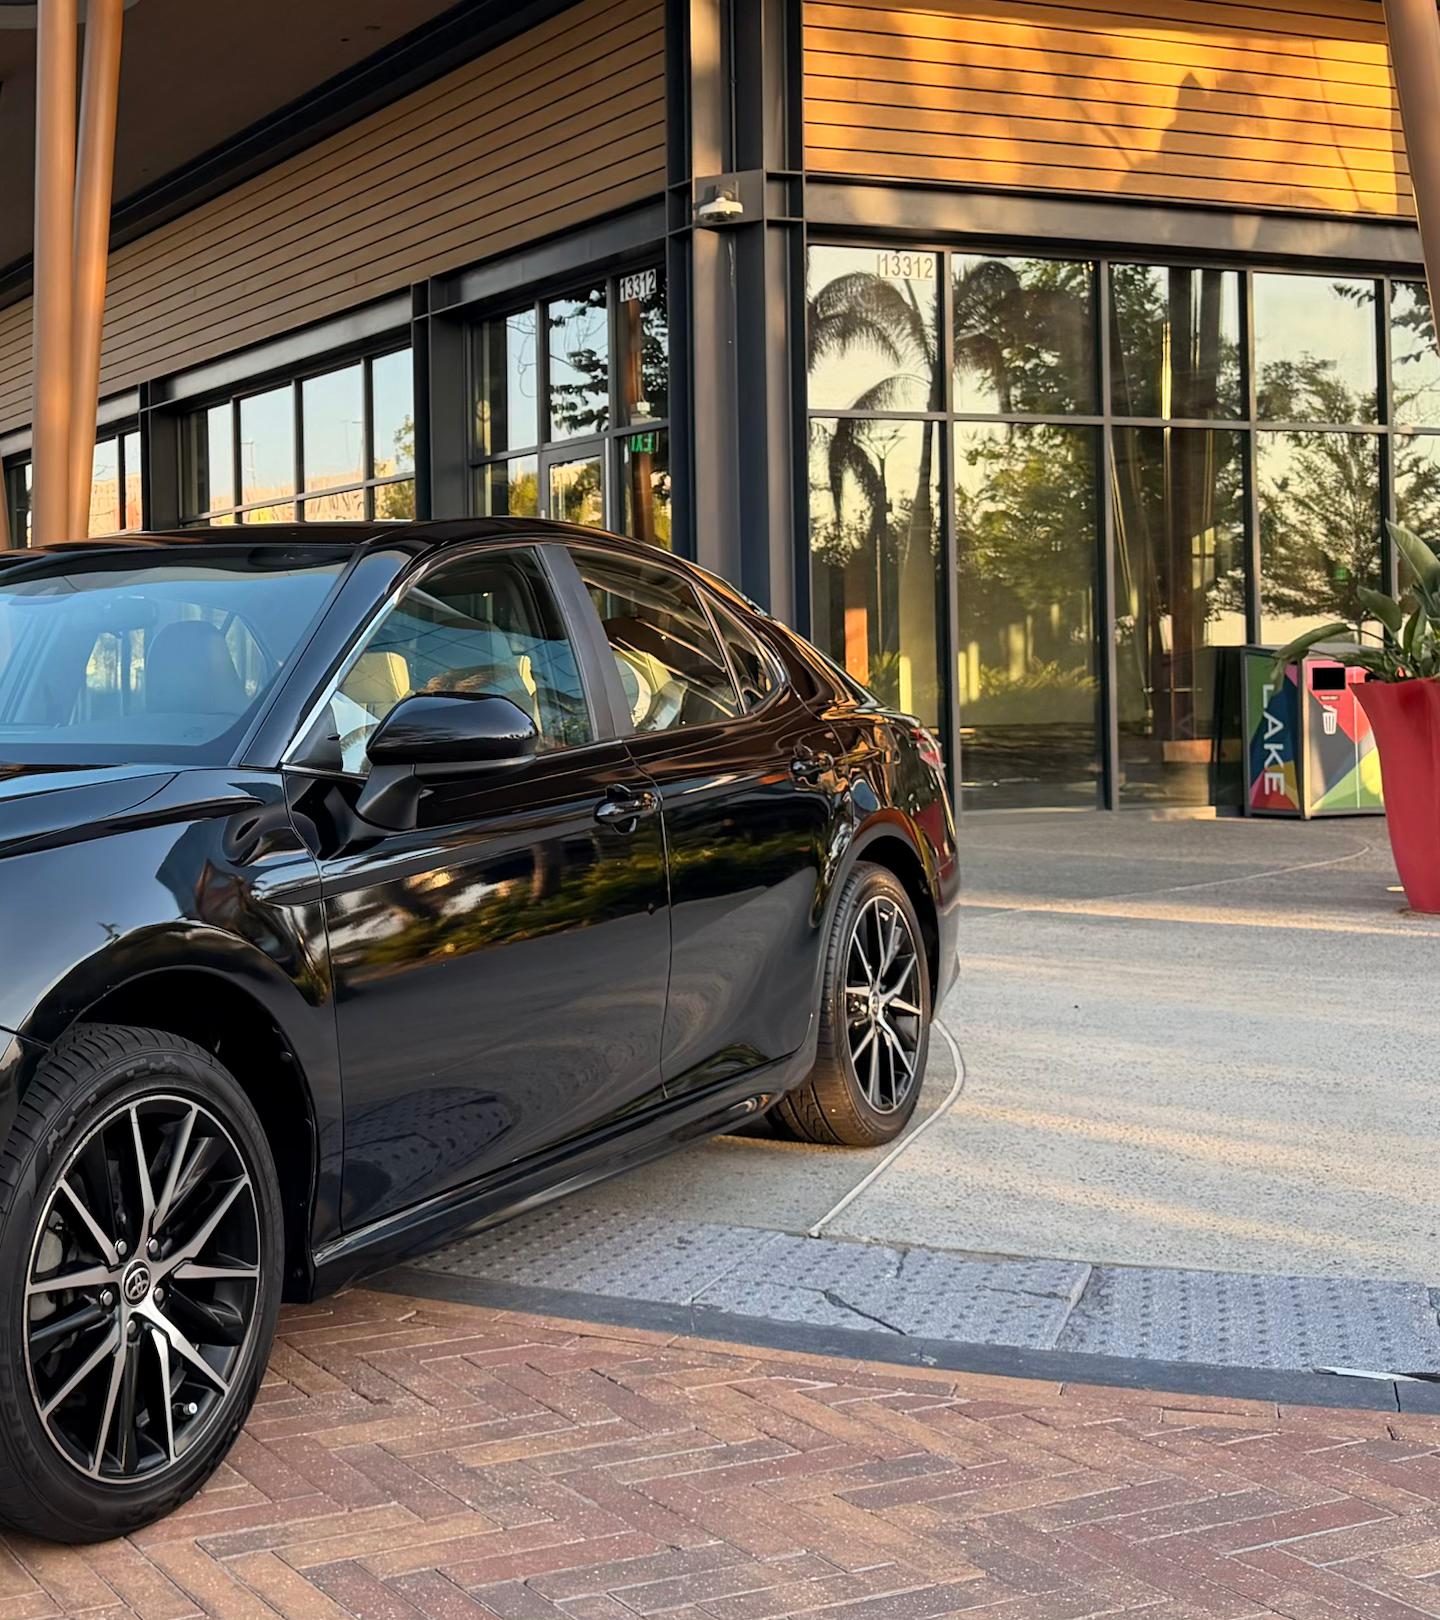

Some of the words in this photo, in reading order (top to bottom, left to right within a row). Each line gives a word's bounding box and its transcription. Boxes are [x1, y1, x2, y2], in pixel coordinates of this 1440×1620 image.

[881, 254, 934, 278] 13312
[622, 271, 656, 300] 13312
[1262, 684, 1285, 796] LAKE
